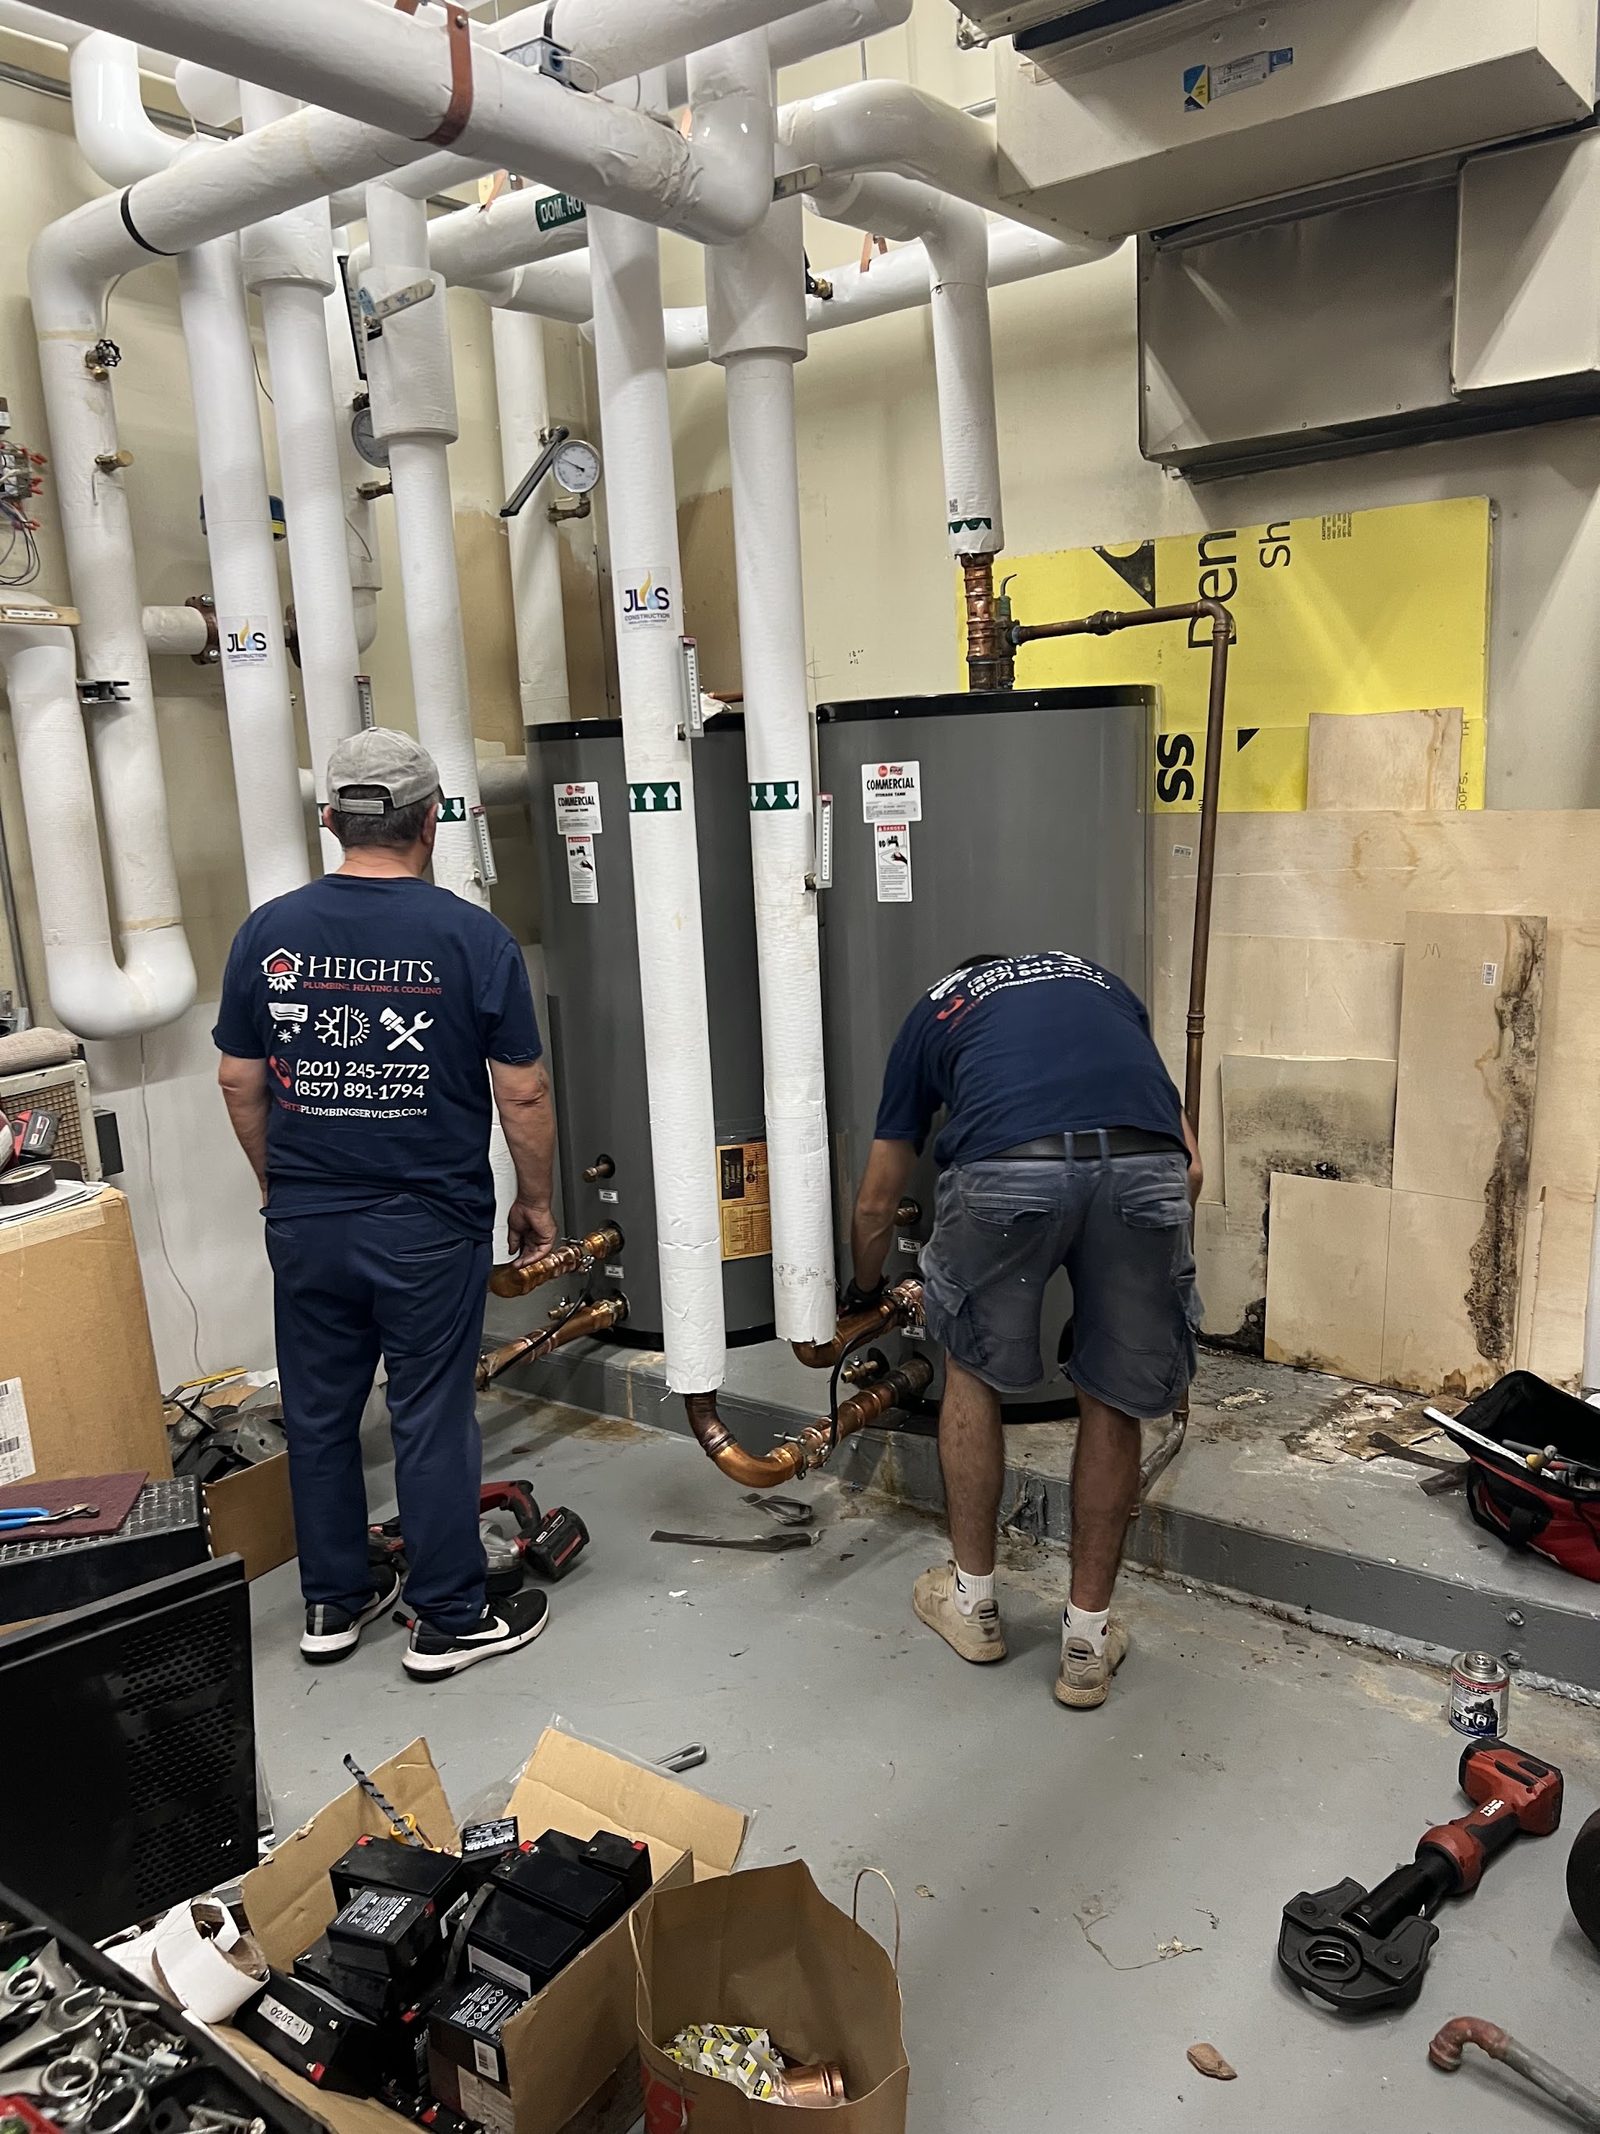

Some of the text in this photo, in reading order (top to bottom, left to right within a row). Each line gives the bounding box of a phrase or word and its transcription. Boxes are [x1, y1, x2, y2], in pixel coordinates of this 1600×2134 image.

[540, 198, 566, 223] DOM.
[1258, 520, 1291, 568] Sh
[624, 613, 671, 621] CONSTRUCTION
[866, 777, 915, 791] COMMERCIAL
[558, 796, 595, 807] COMMERCIAL
[308, 955, 434, 984] HEIGHTS
[967, 965, 1012, 989] (201)
[303, 981, 350, 991] PLUMBING
[353, 984, 393, 993] HEATING
[401, 986, 442, 995] COOLING
[970, 972, 1015, 997] (857)
[296, 1058, 430, 1080] (201) 245-7772
[295, 1079, 425, 1100] (857) 891-1794
